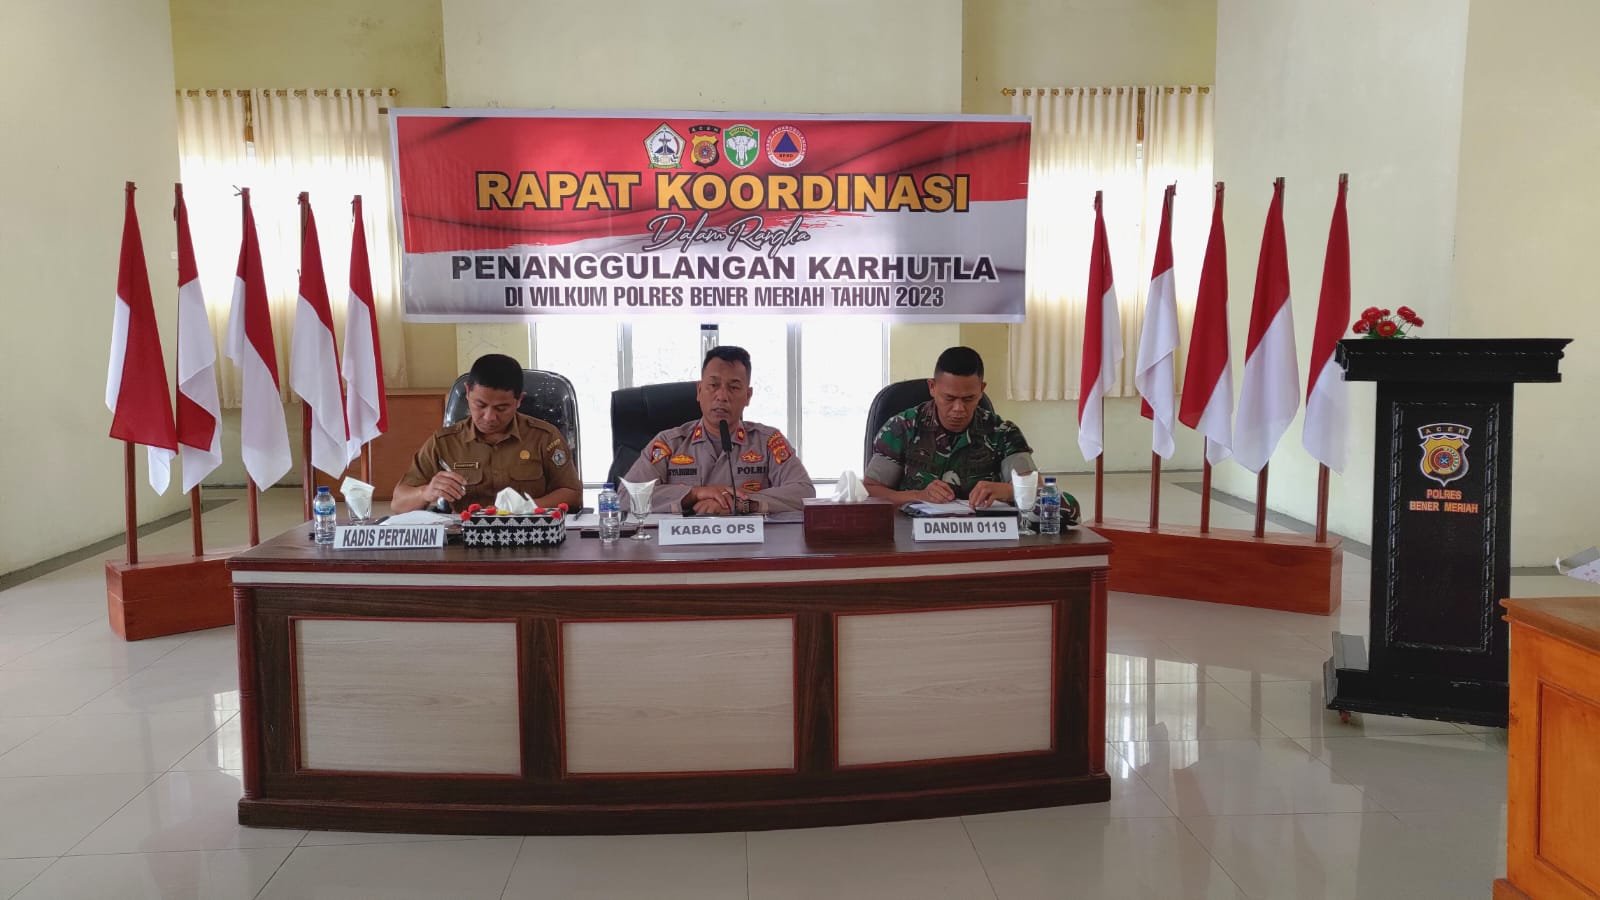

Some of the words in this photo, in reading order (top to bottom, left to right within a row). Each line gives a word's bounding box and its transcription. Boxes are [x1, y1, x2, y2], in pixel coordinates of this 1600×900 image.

[475, 171, 641, 210] RAPAT
[655, 172, 970, 213] KOORDINASI
[642, 211, 727, 254] Dalam
[727, 215, 811, 258] Rangka
[452, 255, 796, 280] PENANGGULANGAN
[808, 256, 997, 281] KARHUTLA
[505, 286, 523, 307] DI
[530, 286, 607, 307] WILKUM
[614, 286, 684, 307] POLRES
[690, 286, 748, 307] BENER
[754, 286, 825, 307] MERIAH
[831, 286, 890, 307] TAHUN
[895, 286, 944, 307] 2023
[1425, 426, 1466, 435] ACEH
[1426, 488, 1463, 500] POLRES
[1409, 500, 1440, 511] BENER
[1444, 502, 1479, 513] MERIAH
[671, 525, 722, 535] KABAG
[726, 524, 756, 534] OPS
[924, 521, 974, 534] DANDIM
[977, 521, 1007, 533] 0119
[343, 528, 375, 546] KADIS
[377, 527, 437, 547] PERTANIAN
